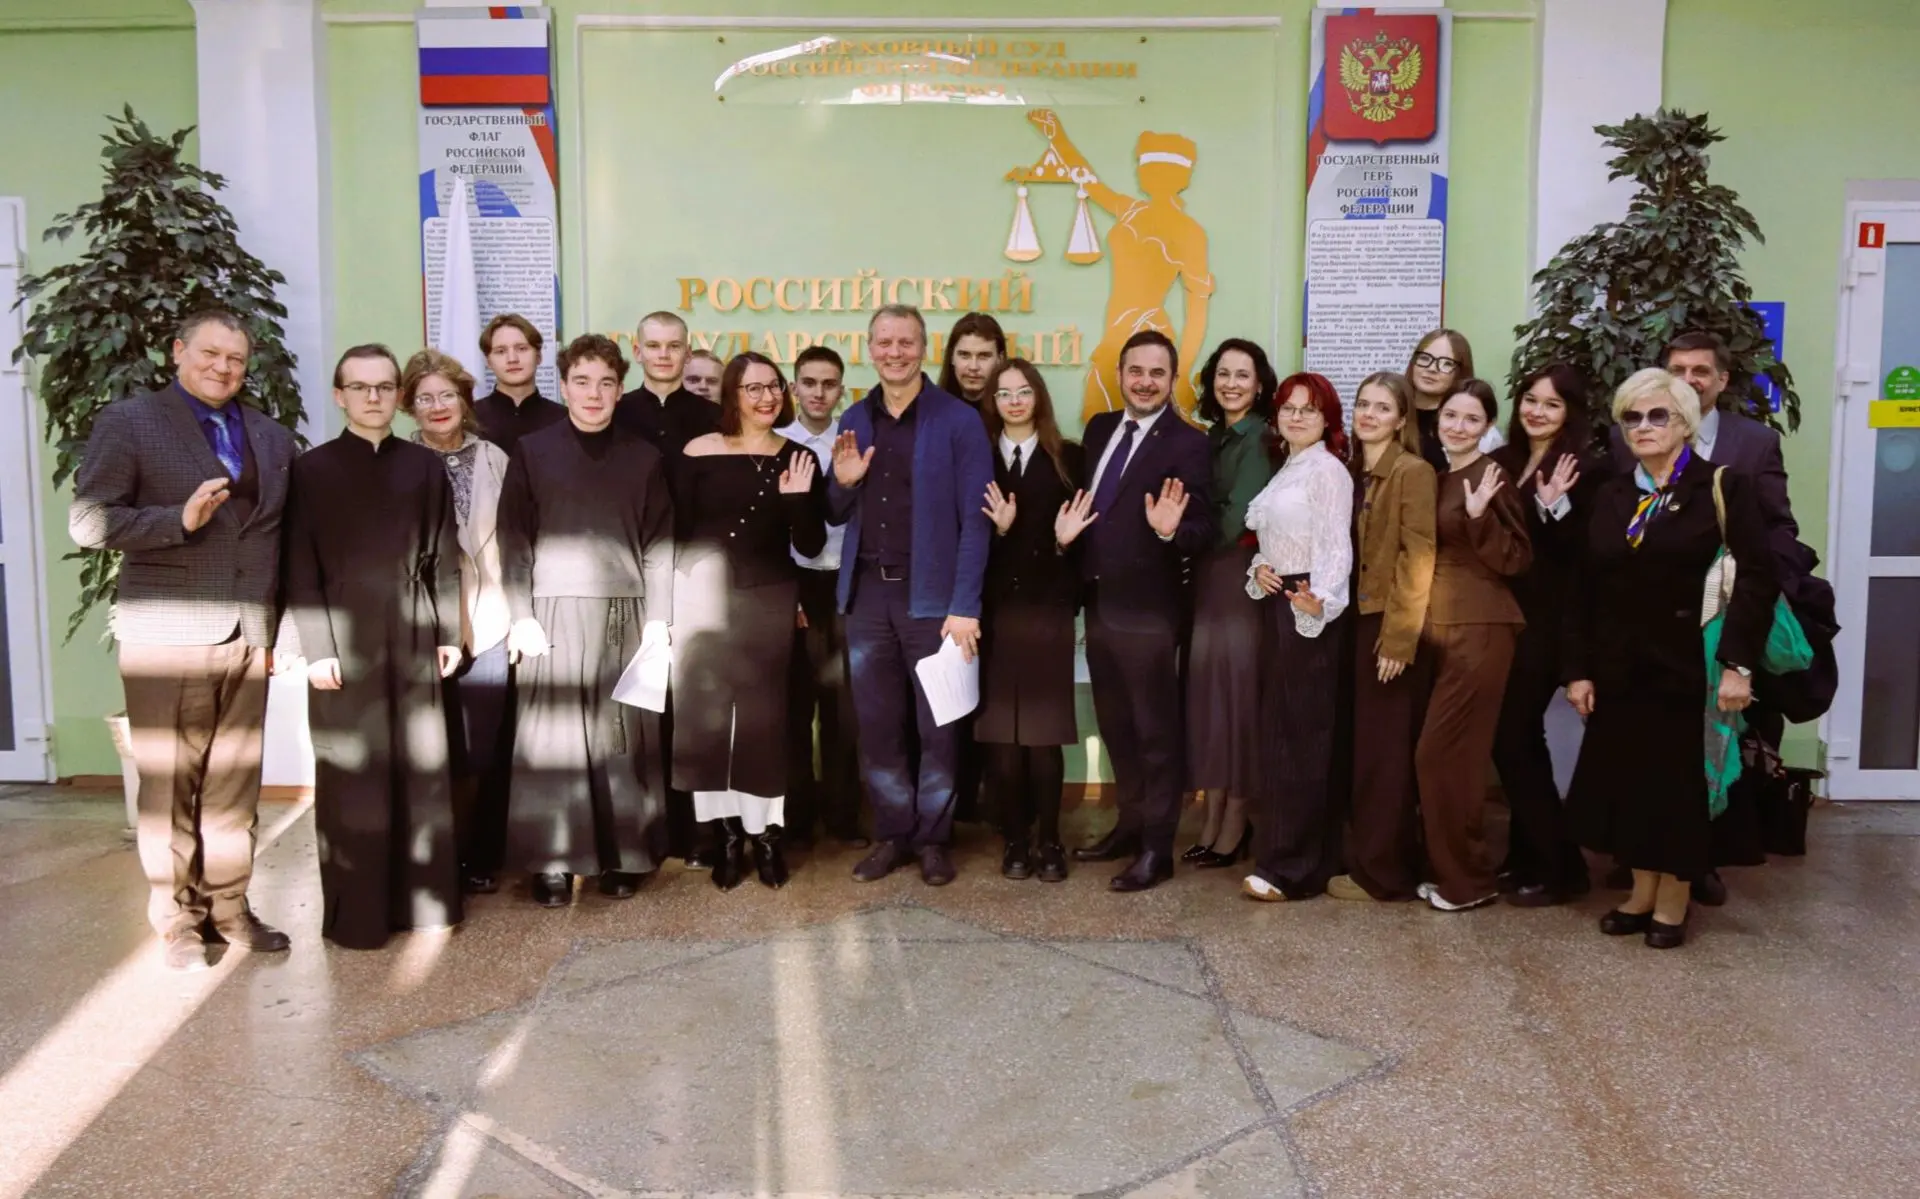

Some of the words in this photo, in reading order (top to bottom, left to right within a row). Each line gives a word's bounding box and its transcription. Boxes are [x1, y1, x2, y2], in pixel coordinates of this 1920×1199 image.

[1006, 41, 1067, 58] СУД
[424, 112, 546, 126] ГОСУДАРСТВЕННЫЙ
[468, 131, 502, 142] ФЛАГ
[445, 146, 526, 158] РОССИЙСКОЙ
[1317, 152, 1440, 165] ГОСУДАРСТВЕННЫЙ
[449, 164, 522, 176] ФЕДЕРАЦИИ
[1363, 171, 1394, 181] ГЕРБ
[1336, 185, 1419, 198] РОССИЙСКОЙ
[1339, 203, 1415, 216] ФЕДЕРАЦИИ
[677, 269, 1035, 313] РОССИЙСКИЙ
